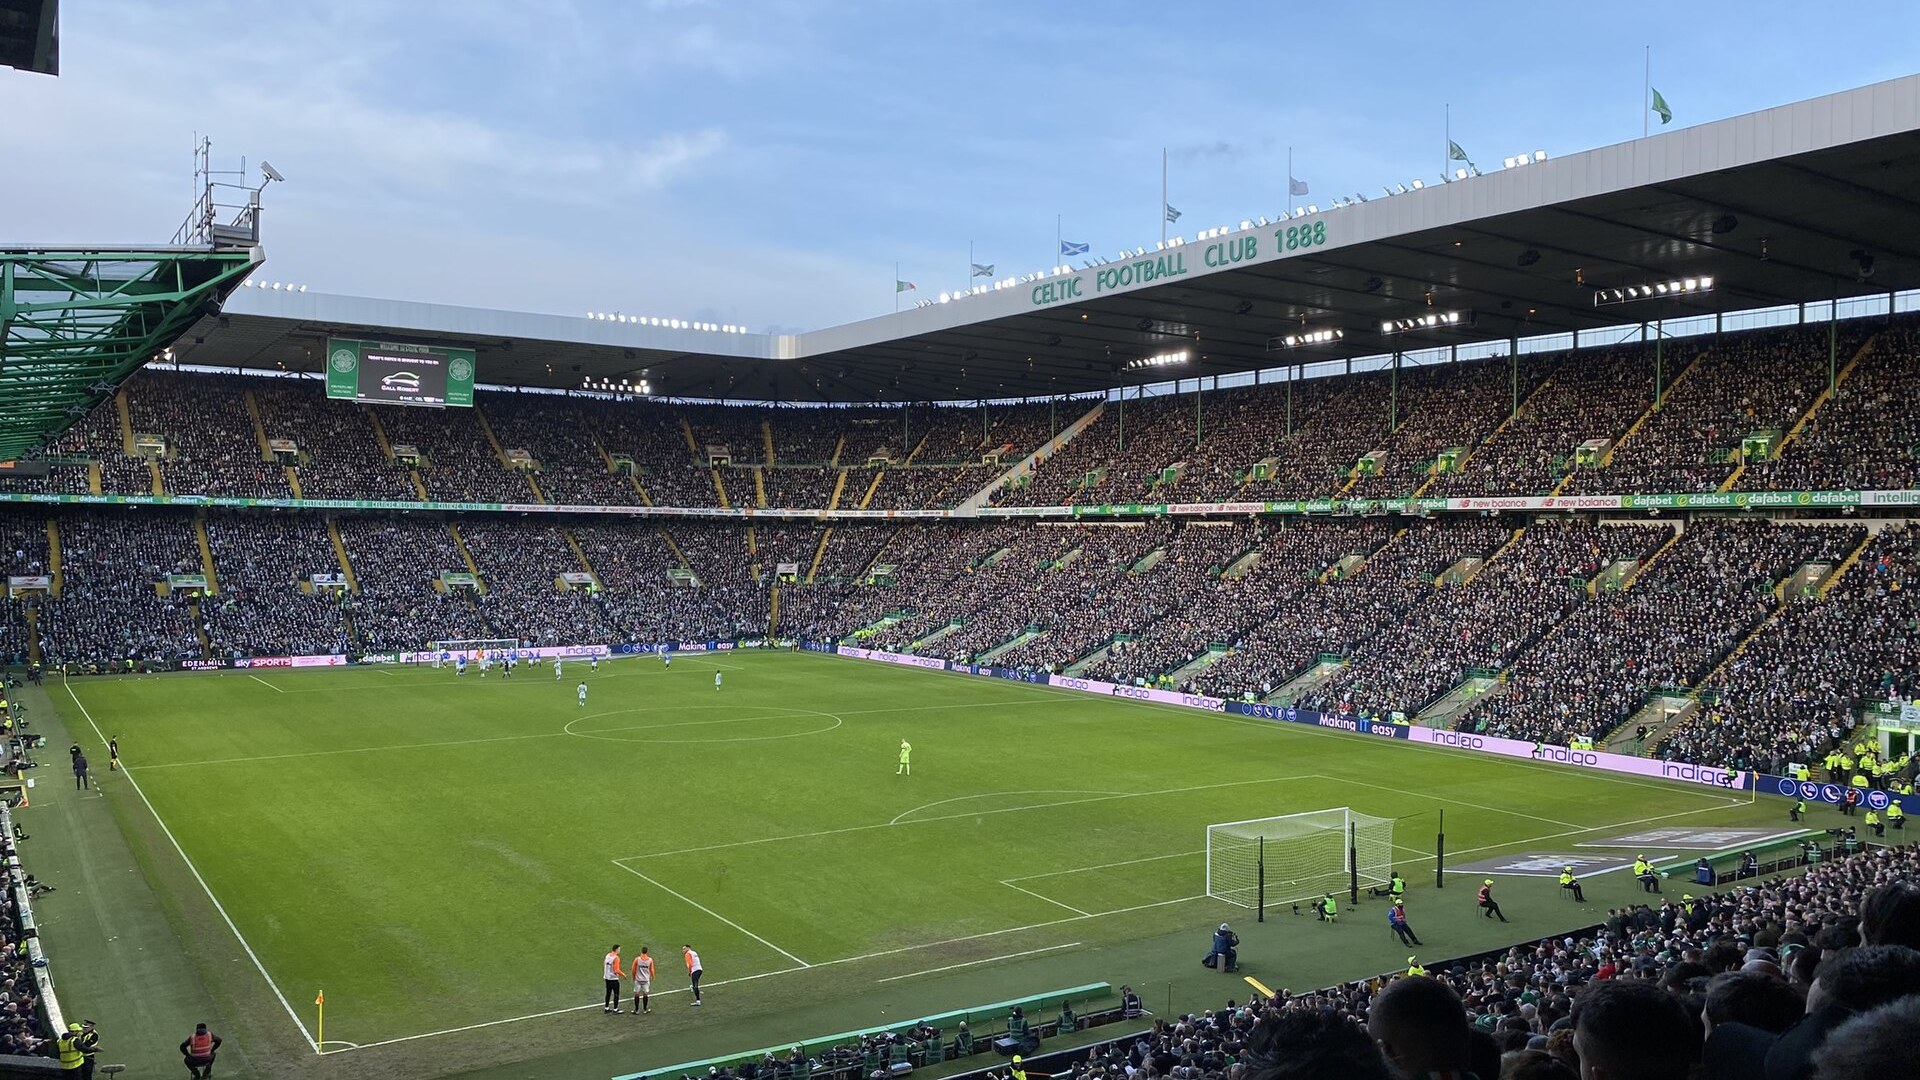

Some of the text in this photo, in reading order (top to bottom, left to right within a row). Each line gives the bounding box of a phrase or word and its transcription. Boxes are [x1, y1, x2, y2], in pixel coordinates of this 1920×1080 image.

[1032, 220, 1327, 305] CELTIC FOOTBALL CLUB 1888
[126, 496, 153, 504] dafabet
[1578, 498, 1618, 506] balance
[1634, 496, 1672, 507] dafabet
[1688, 494, 1730, 506] dafabet
[1749, 493, 1792, 505] dafabet
[1812, 492, 1860, 504] dafabet
[1272, 503, 1296, 511] dafabet
[1306, 502, 1331, 510] dafabet
[1491, 500, 1526, 508] balance
[566, 645, 602, 654] indigo
[679, 641, 706, 651] Making
[717, 642, 734, 650] easy
[362, 653, 394, 662] dafabet
[840, 647, 859, 657] indigo
[878, 652, 898, 663] indigo
[234, 660, 250, 668] sky
[254, 658, 292, 666] SPORTS
[952, 662, 971, 674] Making
[978, 666, 992, 678] easy
[1060, 676, 1088, 690] indigo
[1182, 693, 1218, 710] indigo
[1319, 713, 1396, 738] Making IT easy
[1432, 729, 1483, 750] indigo
